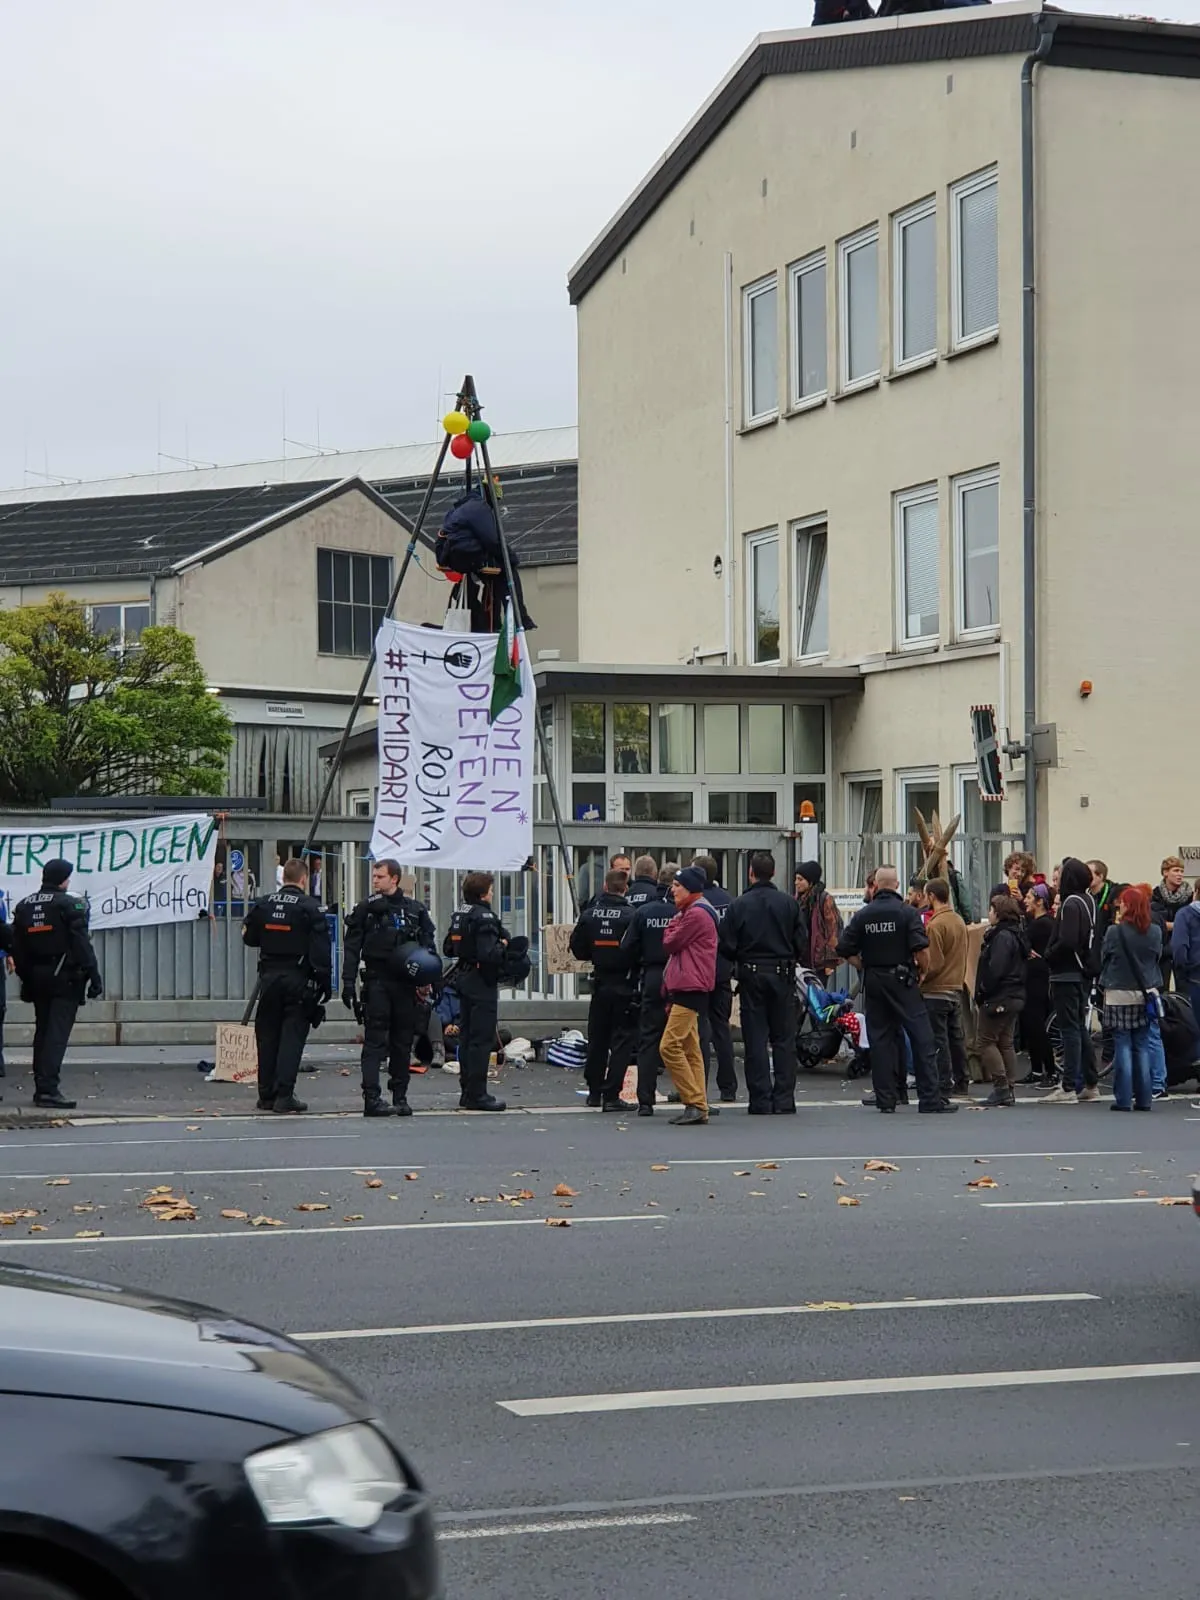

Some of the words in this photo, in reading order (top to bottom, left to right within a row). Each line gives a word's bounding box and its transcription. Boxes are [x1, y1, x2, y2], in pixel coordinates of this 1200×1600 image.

[378, 648, 410, 848] #FEMIDARITY
[492, 659, 529, 825] OMEN
[454, 683, 490, 838] DEFEND
[415, 741, 453, 851] ROJAVA
[24, 893, 55, 905] POLIZEI
[101, 874, 207, 916] abschaffen
[267, 894, 299, 904] POLIZEI
[592, 908, 621, 919] POLIZEI
[865, 921, 896, 934] POLIZEI
[219, 1027, 249, 1050] Krieg
